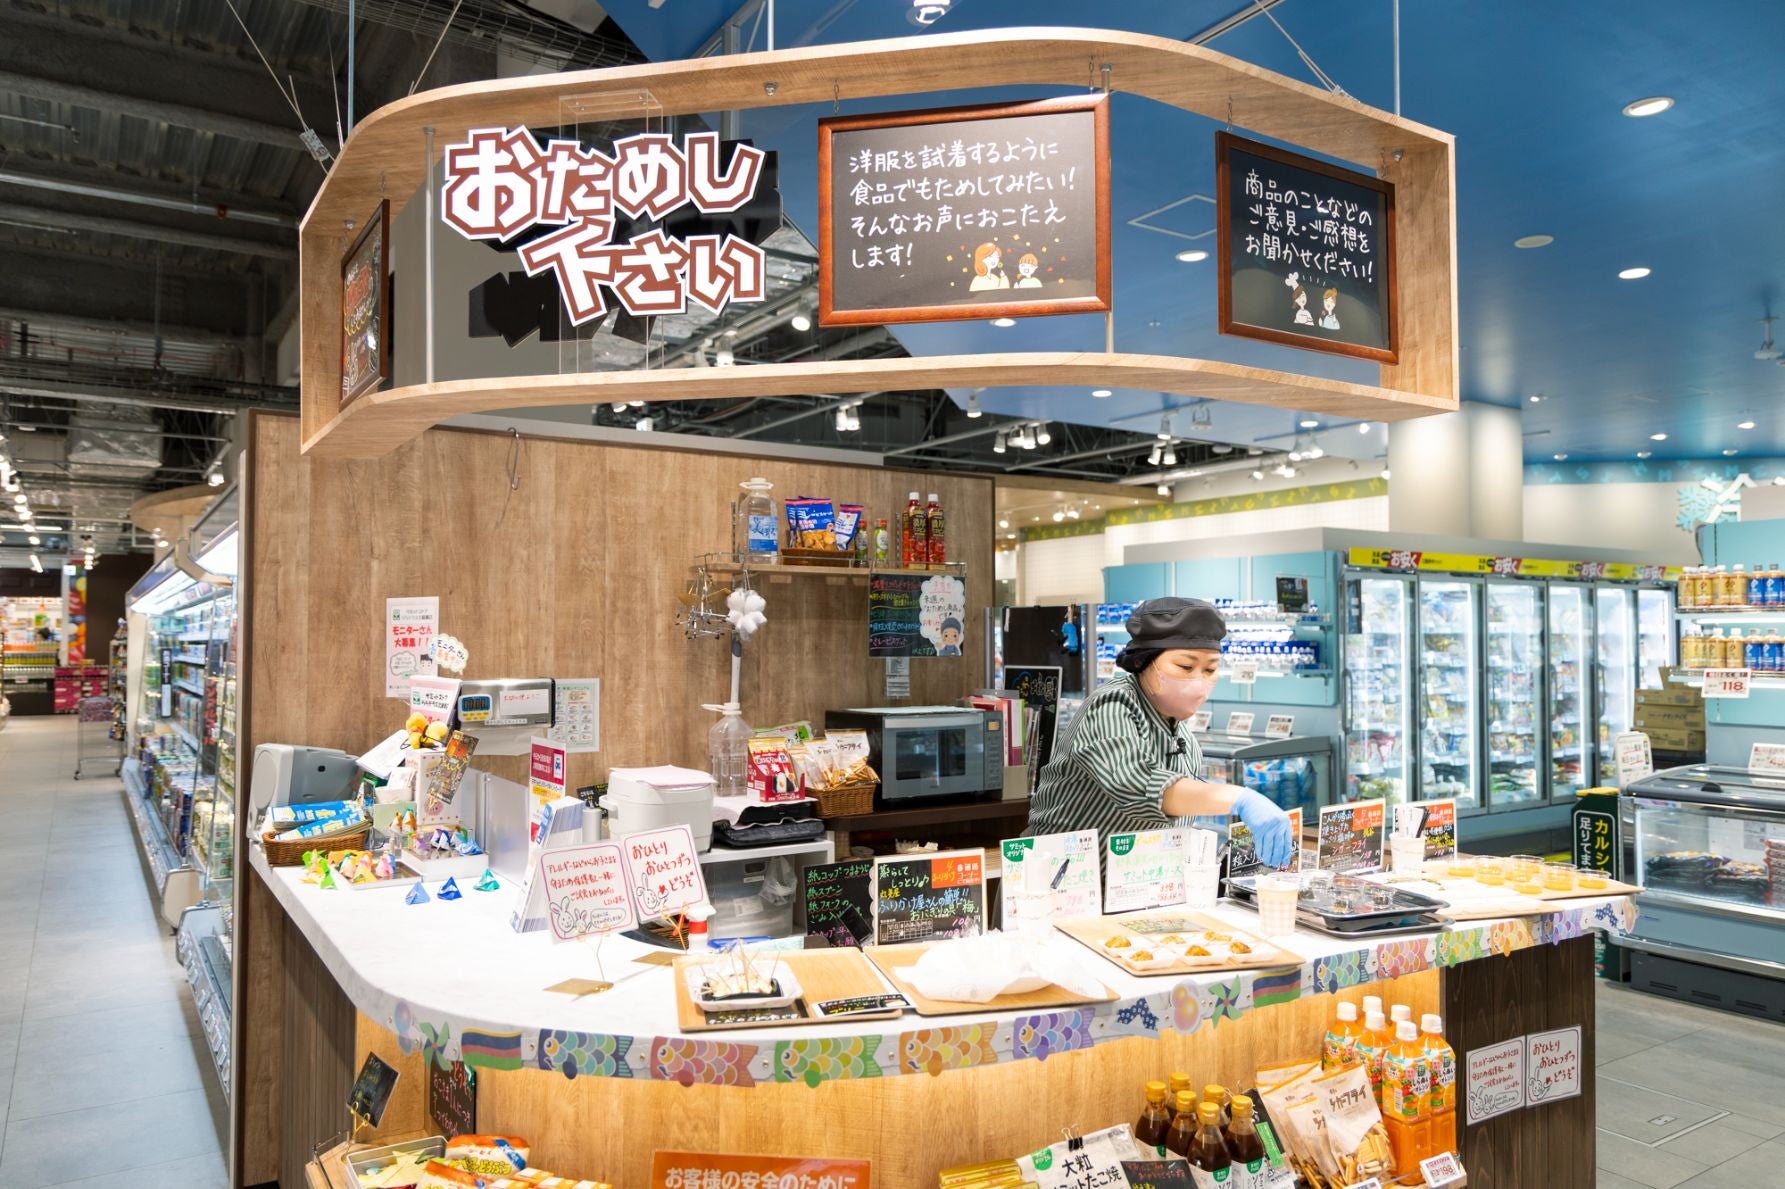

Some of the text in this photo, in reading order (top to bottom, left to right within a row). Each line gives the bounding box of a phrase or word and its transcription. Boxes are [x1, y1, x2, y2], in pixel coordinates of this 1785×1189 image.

[849, 137, 1059, 174] 洋服を試着するように
[442, 125, 766, 243] おためし
[1245, 169, 1372, 226] 商品のことなどの
[850, 198, 1066, 237] そんなお声におこたえ
[1249, 203, 1370, 253] ご意見・ご感想を
[852, 242, 913, 269] します!
[1245, 233, 1373, 283] お聞かせください!
[517, 217, 766, 327] 下さい
[392, 626, 433, 636] モニターさん
[1723, 681, 1744, 691] 118
[632, 841, 668, 860] おひとり
[1009, 842, 1026, 850] サミット
[1579, 816, 1593, 869] 足りてま
[1594, 819, 1610, 871] カルシ
[646, 853, 691, 876] おひとつずつ
[669, 870, 694, 892] どうぞ
[1533, 1040, 1560, 1055] おひとり
[1540, 1051, 1576, 1068] おひとつずつ
[1554, 1066, 1576, 1082] どうぞ
[1061, 1152, 1094, 1178] 大粒
[665, 1168, 856, 1189] お客様の安全のために
